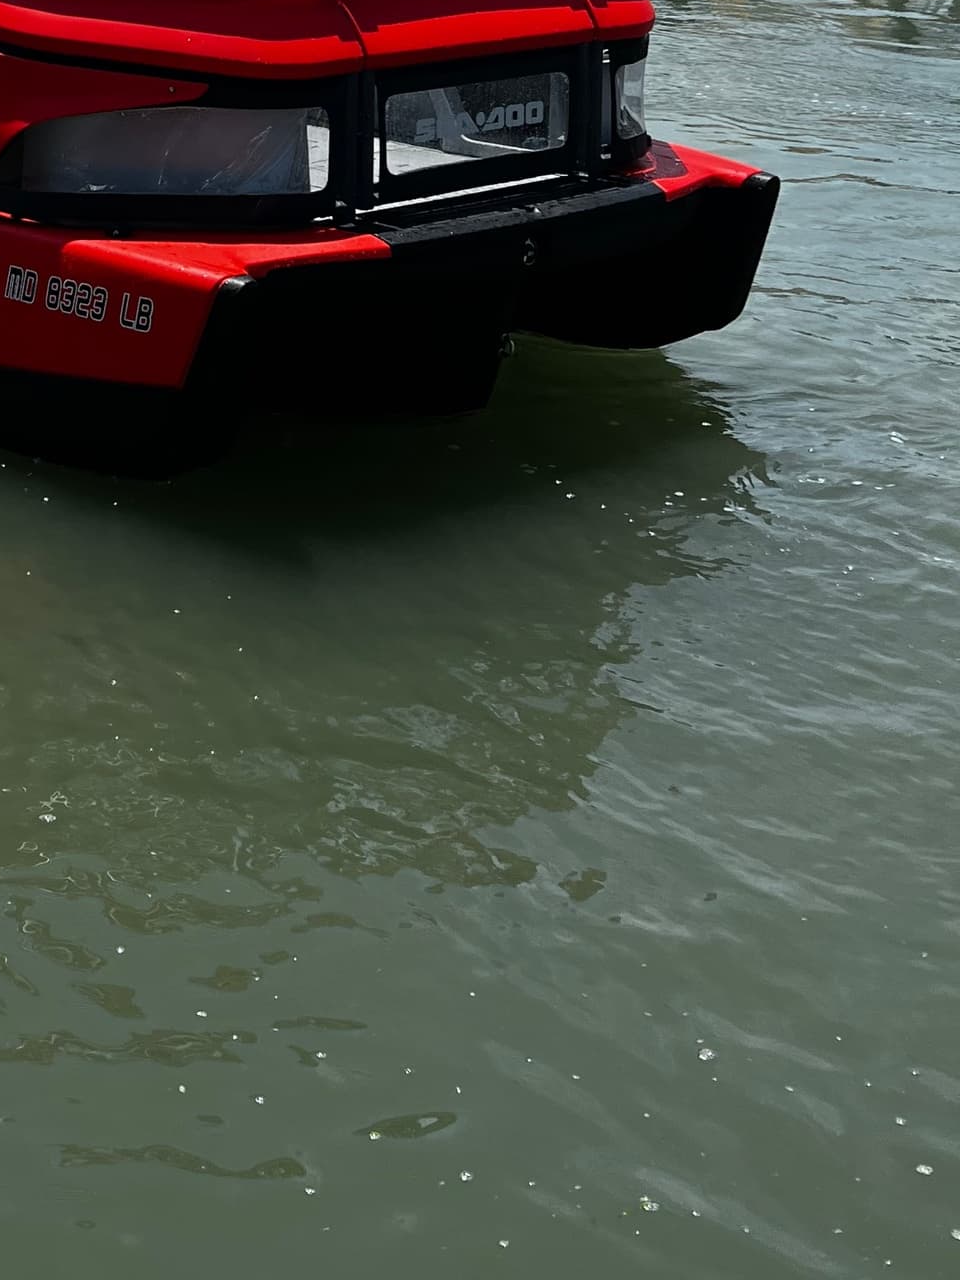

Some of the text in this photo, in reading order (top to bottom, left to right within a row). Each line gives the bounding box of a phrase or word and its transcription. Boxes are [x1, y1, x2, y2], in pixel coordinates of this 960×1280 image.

[4, 264, 39, 305] MD
[45, 275, 109, 322] 8323
[119, 292, 154, 333] LB
